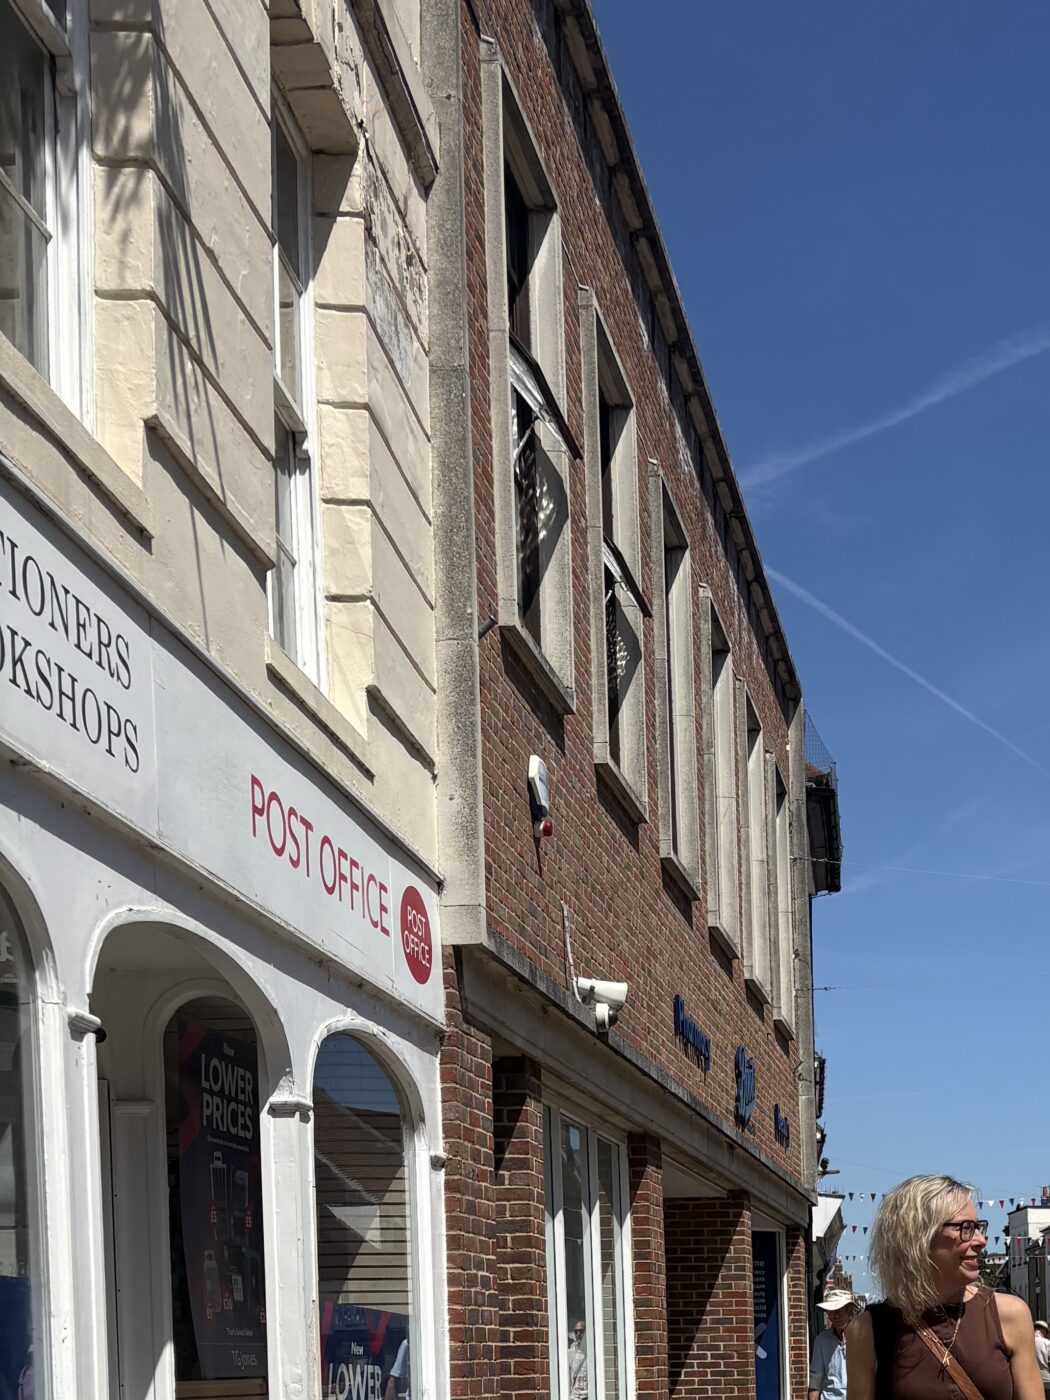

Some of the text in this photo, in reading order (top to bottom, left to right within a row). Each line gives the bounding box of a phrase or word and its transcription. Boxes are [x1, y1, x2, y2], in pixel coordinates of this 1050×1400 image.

[0, 530, 131, 690] IONERS
[0, 623, 140, 774] KSHOPS
[251, 774, 390, 938] POST OFFICE
[407, 906, 426, 938] POST
[403, 932, 430, 968] OFFICE
[202, 1053, 254, 1105] LOWER
[203, 1091, 254, 1140] PRICES
[350, 1341, 364, 1355] New
